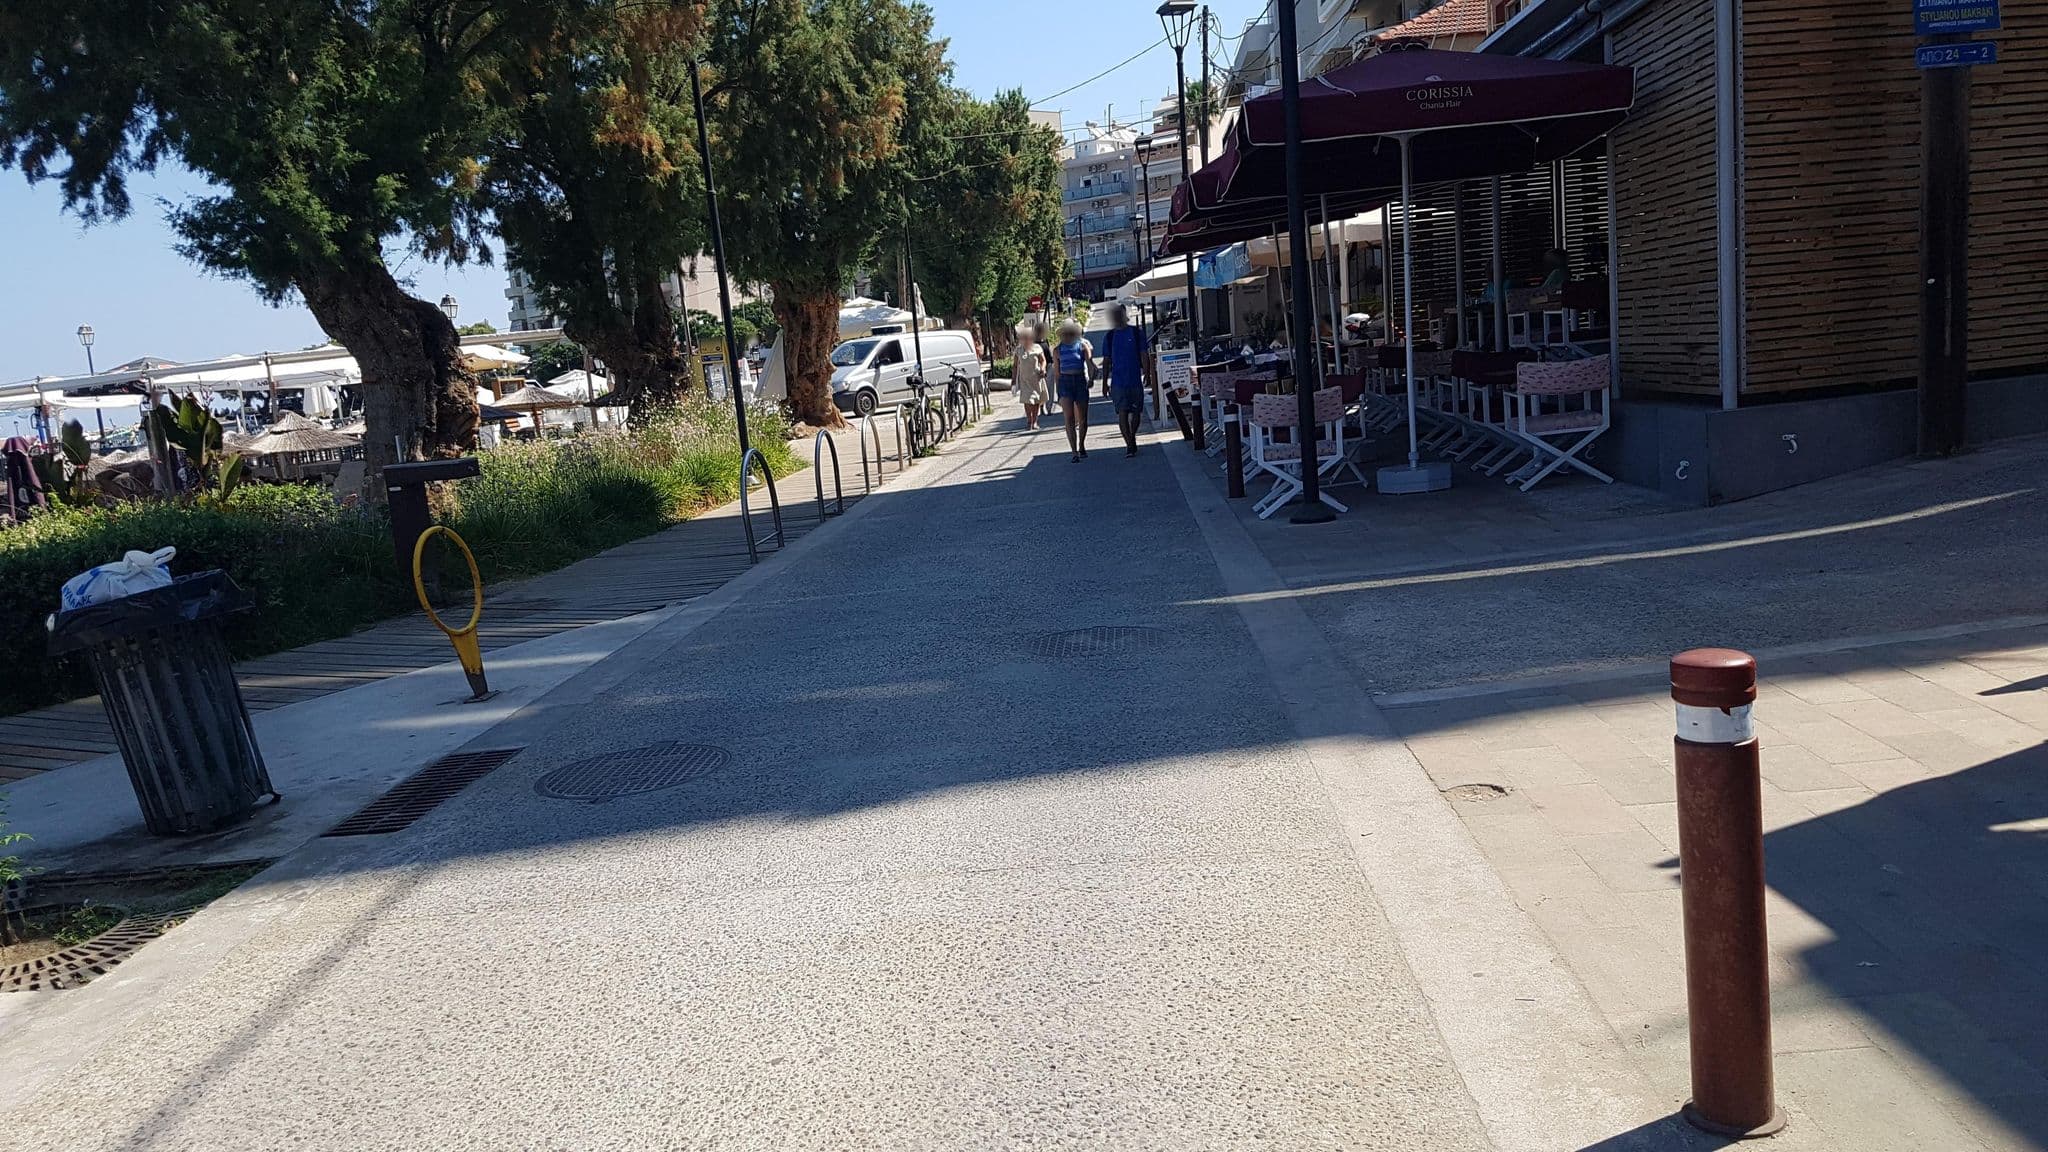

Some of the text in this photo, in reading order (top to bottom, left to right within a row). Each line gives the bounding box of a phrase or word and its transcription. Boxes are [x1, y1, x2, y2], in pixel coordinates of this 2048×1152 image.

[1920, 9, 1960, 22] STYLIANOU
[1945, 49, 1959, 60] 24
[1982, 47, 1989, 58] 2
[1407, 86, 1473, 101] CORISSIA
[1420, 100, 1461, 110] Chania Flair
